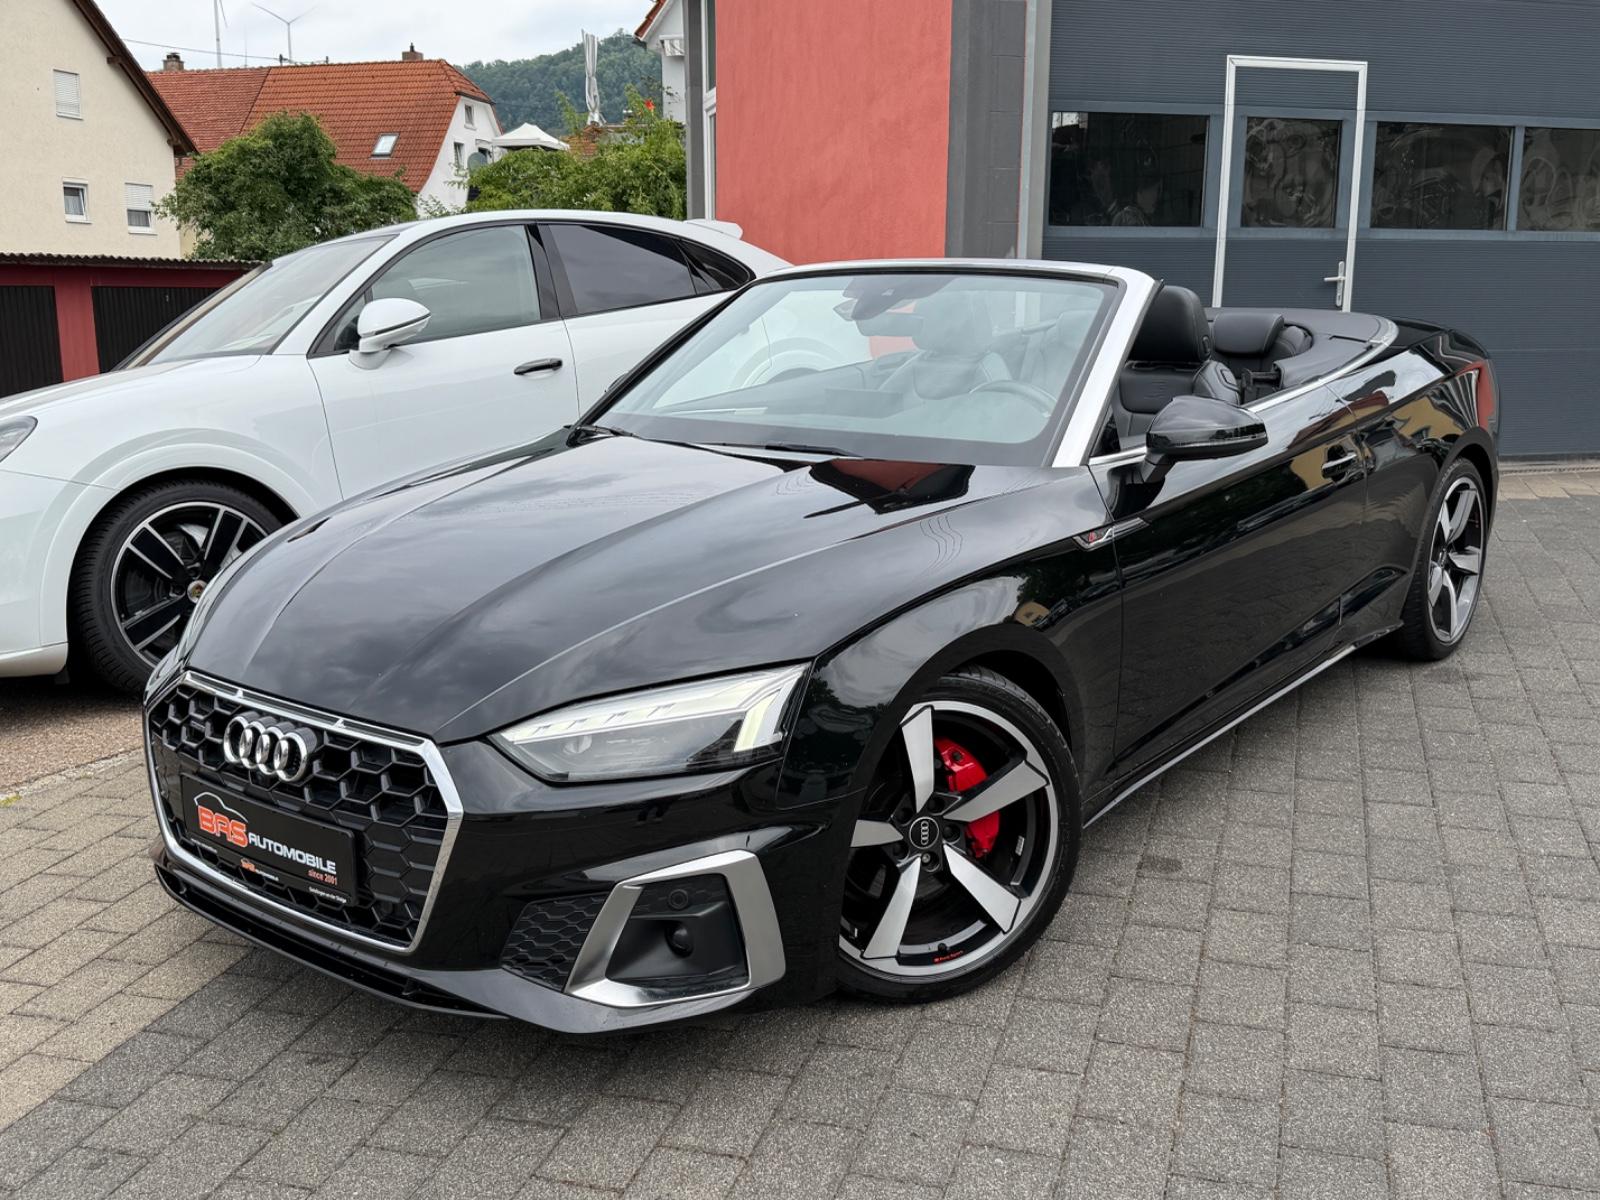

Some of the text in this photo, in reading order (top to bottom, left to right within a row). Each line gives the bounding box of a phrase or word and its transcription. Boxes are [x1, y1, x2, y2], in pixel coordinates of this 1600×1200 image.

[198, 805, 248, 847] BAS
[248, 832, 337, 875] AUTOMOBILE
[307, 868, 338, 886] since 2001
